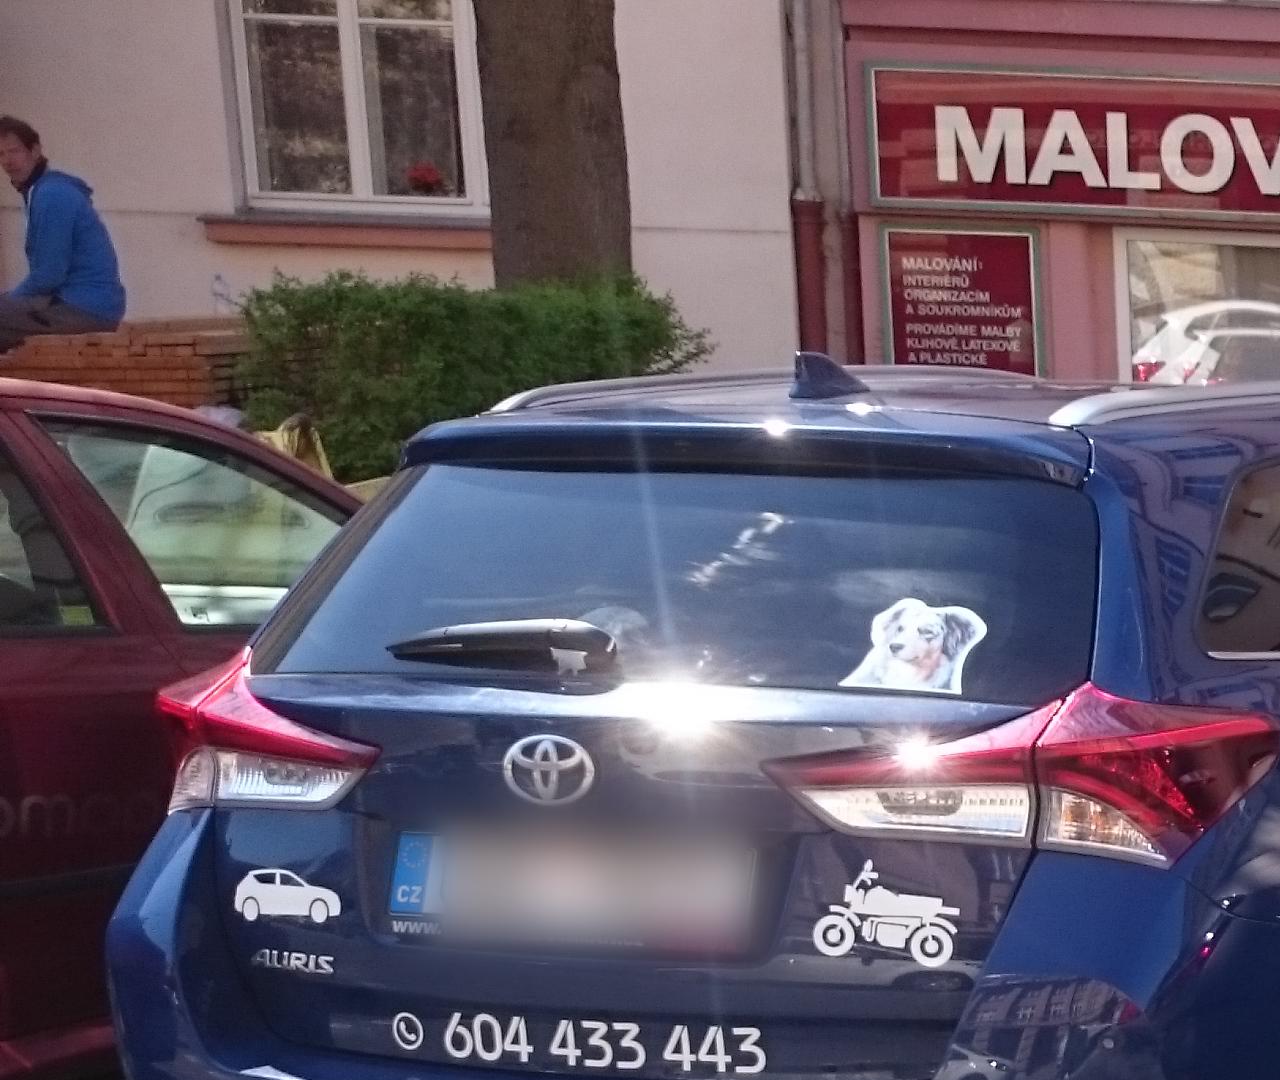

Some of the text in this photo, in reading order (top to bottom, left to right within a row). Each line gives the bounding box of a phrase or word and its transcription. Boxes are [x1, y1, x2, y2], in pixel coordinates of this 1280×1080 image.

[905, 304, 915, 315] A
[981, 325, 1021, 338] MALBY
[908, 352, 917, 363] A
[397, 885, 423, 903] CZ
[252, 949, 334, 975] AURIS
[443, 1011, 767, 1074] 604 433 443
